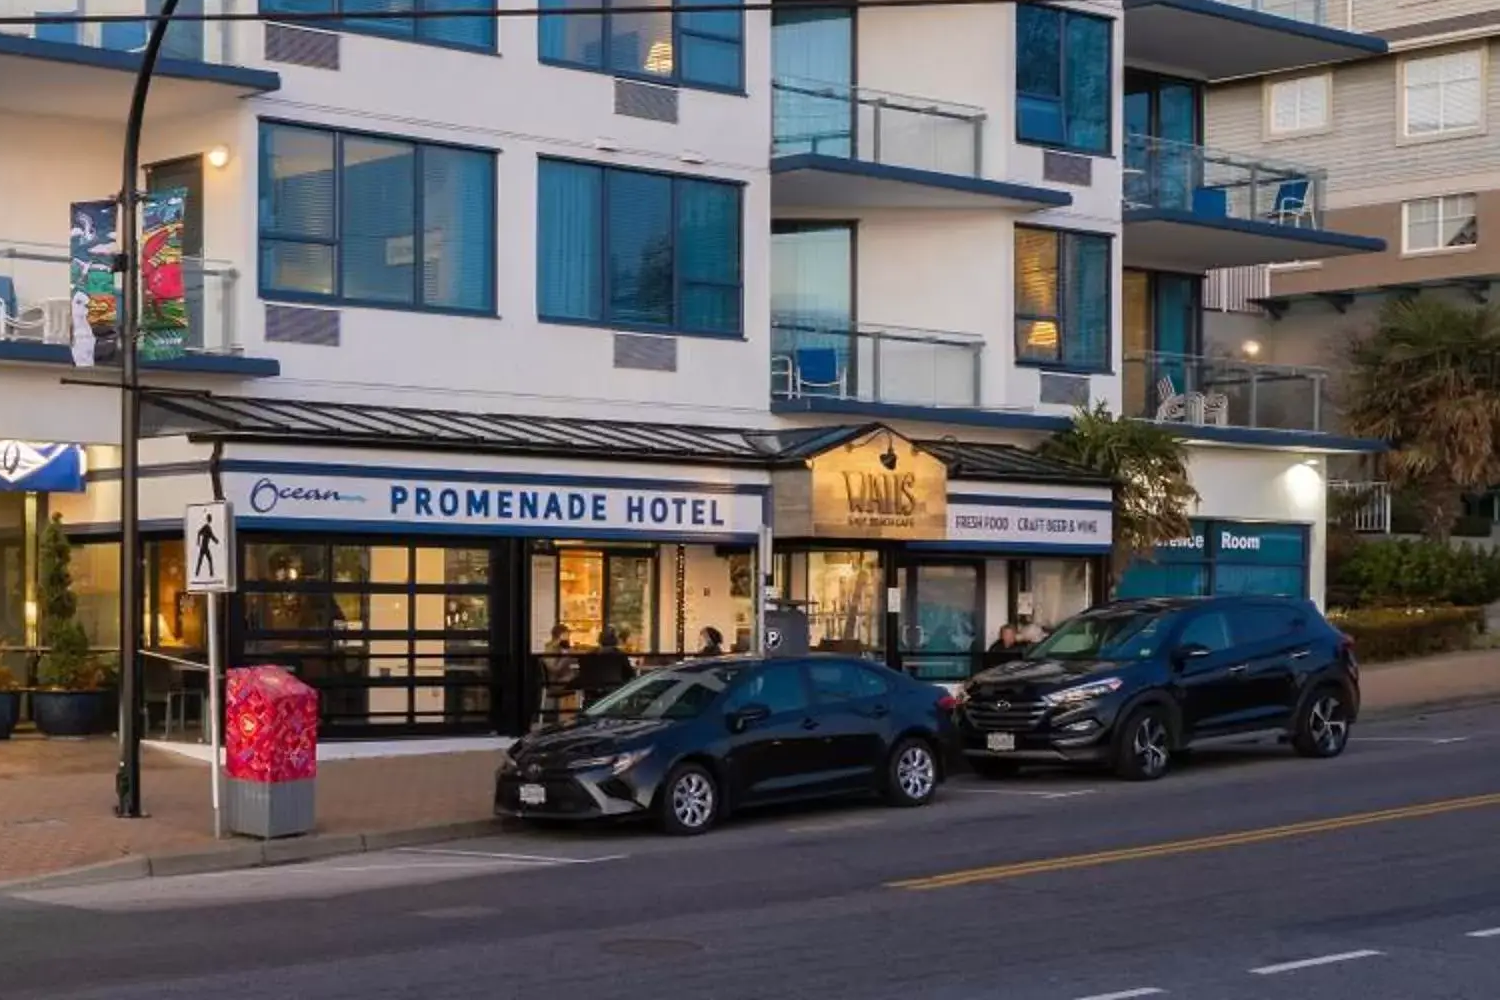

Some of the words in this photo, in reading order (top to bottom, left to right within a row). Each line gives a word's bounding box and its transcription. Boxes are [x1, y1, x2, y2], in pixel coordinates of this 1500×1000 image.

[250, 478, 342, 513] Ocean
[390, 485, 607, 521] PROMENADE
[626, 495, 725, 526] HOTEL
[955, 515, 983, 529] FRESH
[984, 516, 1009, 531] FOOD
[1017, 517, 1045, 532] CRAFT
[1046, 518, 1066, 533] BEER
[1221, 532, 1261, 550] Room
